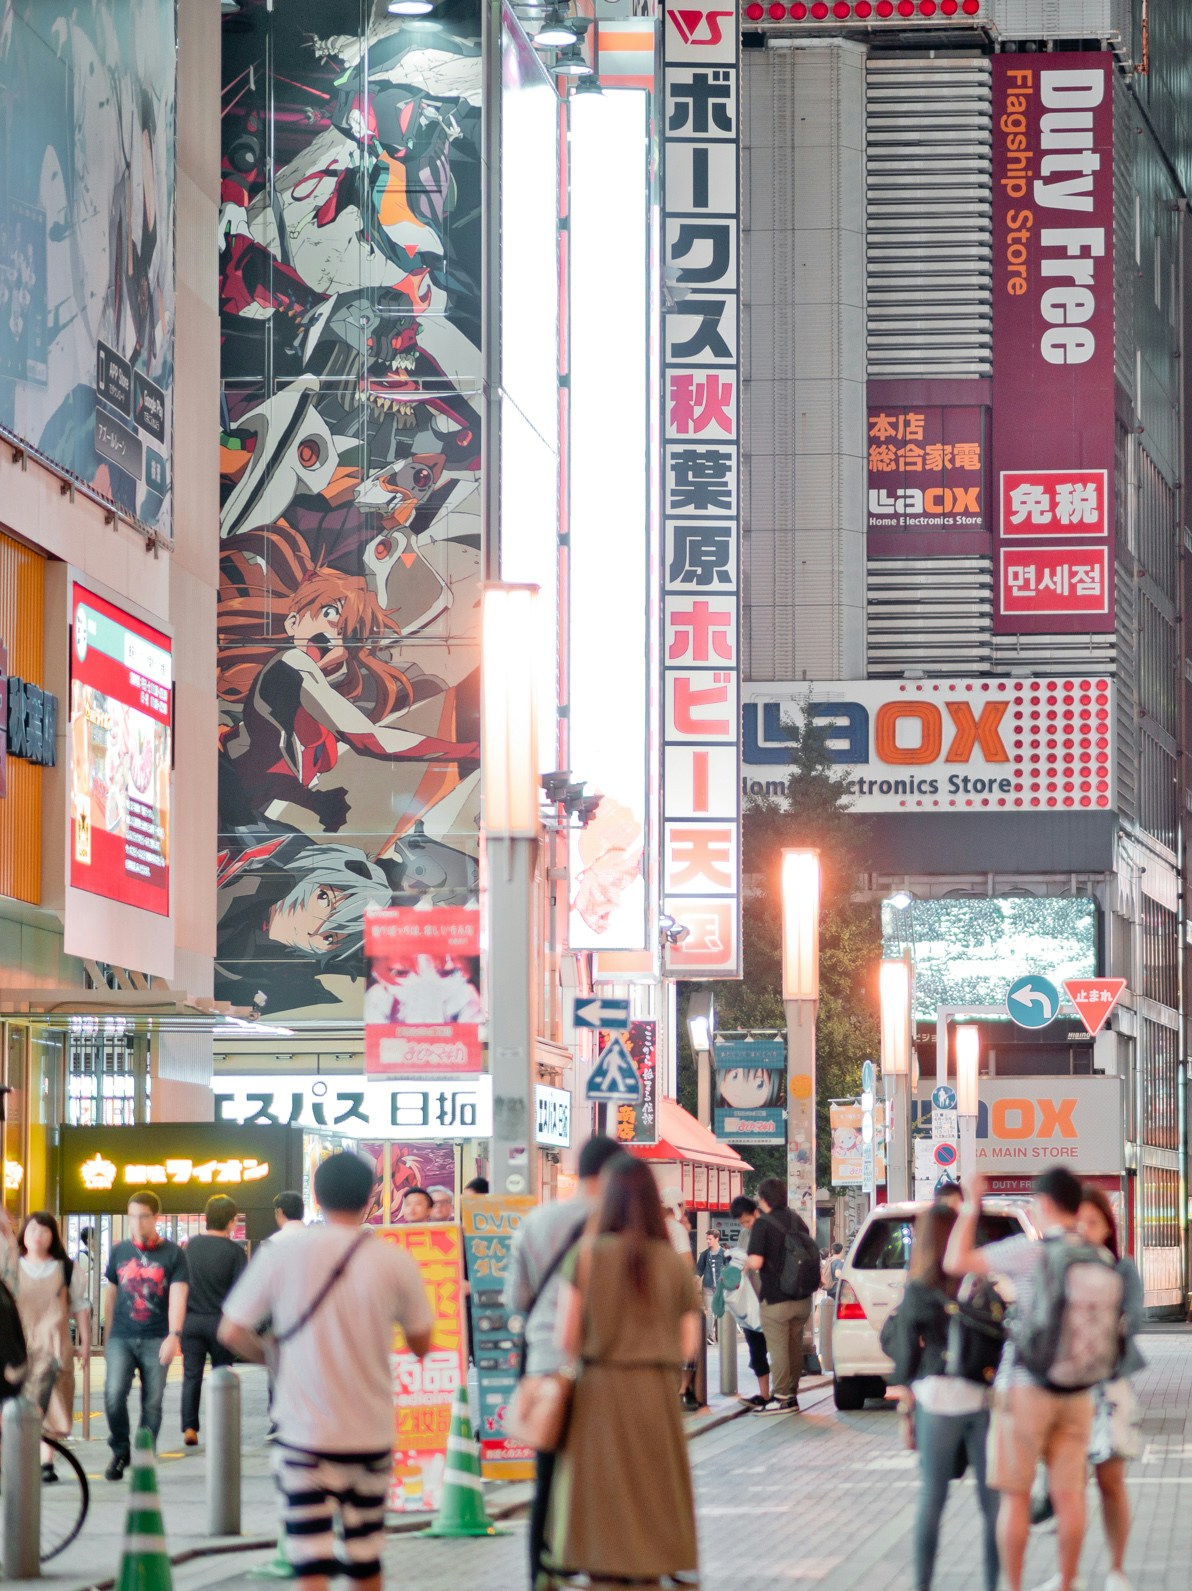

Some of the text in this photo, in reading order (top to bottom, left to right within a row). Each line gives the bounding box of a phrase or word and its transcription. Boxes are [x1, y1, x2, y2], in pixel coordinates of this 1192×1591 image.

[1000, 70, 1034, 296] Flagship Store
[1034, 68, 1105, 364] Duty Free
[868, 412, 925, 441] 本店
[868, 442, 981, 472] 総合家電
[1009, 482, 1099, 525] 免税
[869, 515, 983, 526] Home Electronics Store
[1008, 564, 1101, 597] 면세점
[948, 774, 1012, 794] Store
[1075, 989, 1113, 1003] 止まれ
[912, 1098, 1078, 1139] OX
[992, 1148, 1032, 1158] MAIN
[1038, 1147, 1078, 1157] STORE
[992, 1180, 1018, 1190] DUTY
